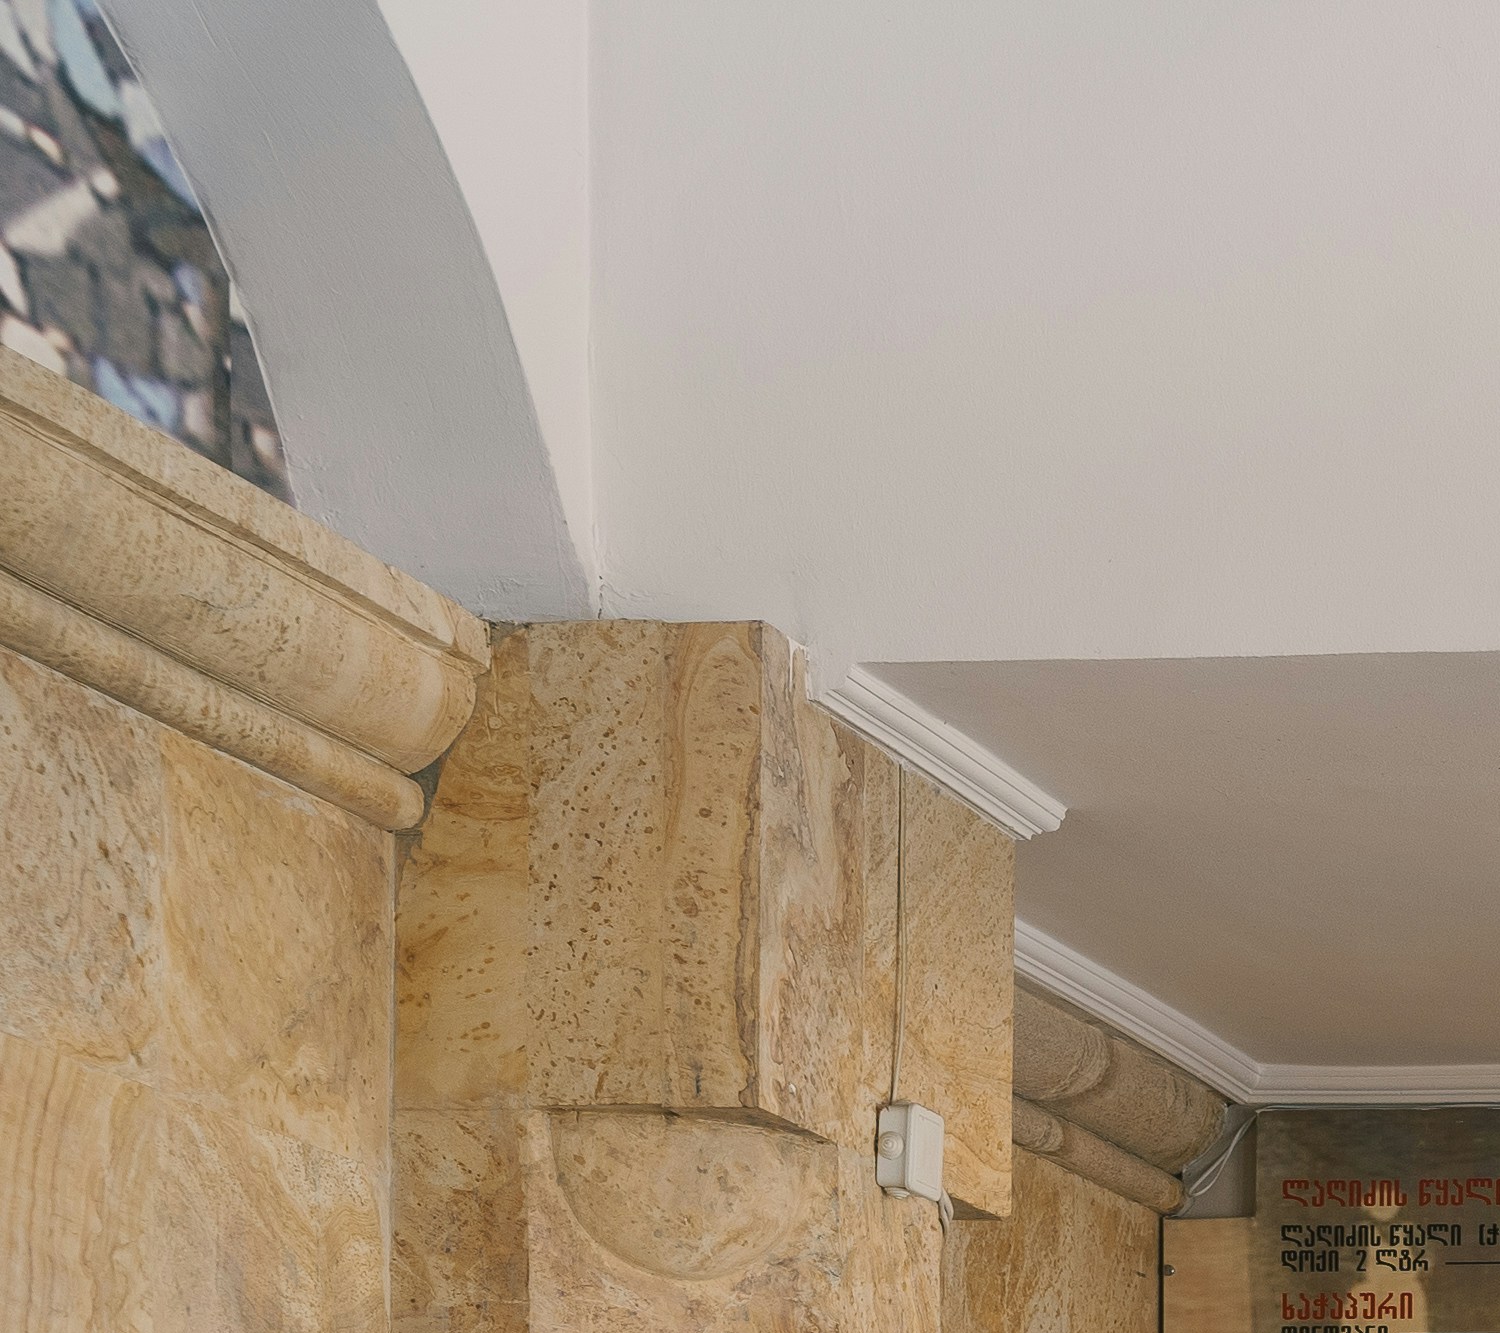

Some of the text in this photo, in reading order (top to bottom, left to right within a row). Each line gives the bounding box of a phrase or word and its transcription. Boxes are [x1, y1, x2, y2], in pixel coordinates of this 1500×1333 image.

[1282, 1179, 1408, 1207] ლაღიძის
[1281, 1225, 1381, 1247] ლაღიძის
[1389, 1224, 1462, 1246] წყალი
[1281, 1251, 1340, 1272] დოქი
[1356, 1251, 1367, 1272] 2
[1282, 1292, 1413, 1320] ხაჭაპური
